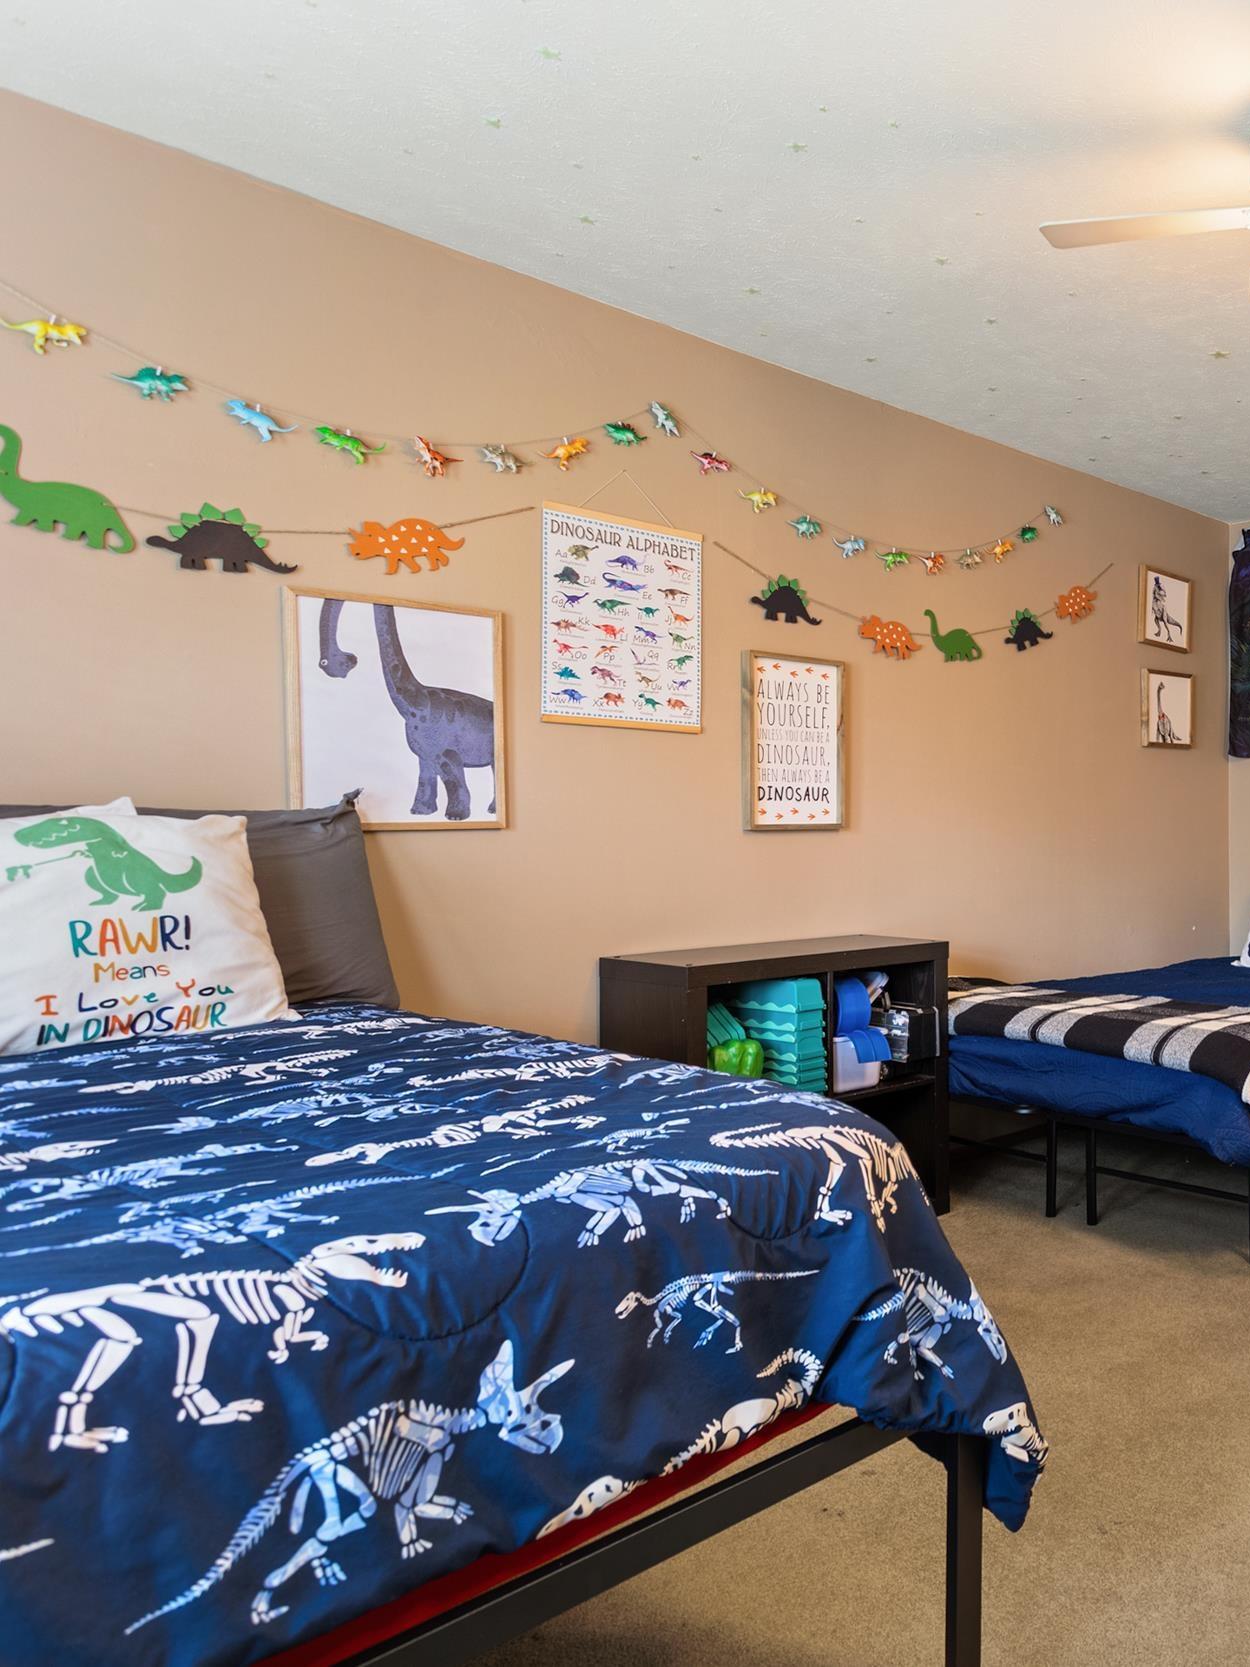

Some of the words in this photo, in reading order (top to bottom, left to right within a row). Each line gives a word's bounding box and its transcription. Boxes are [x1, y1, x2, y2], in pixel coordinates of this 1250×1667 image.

[551, 519, 621, 547] DINOSAUR
[626, 535, 696, 561] ALPHABET
[757, 678, 809, 701] ALWAYS
[816, 683, 830, 705] BE
[757, 702, 830, 730] YOURSELF,
[757, 727, 783, 742] UNLESS
[785, 730, 799, 742] YOU
[800, 730, 815, 743] CAN
[816, 731, 824, 744] BE
[826, 732, 830, 743] A
[757, 767, 778, 783] THEN
[782, 768, 812, 784] ALWAYS
[814, 769, 823, 784] BE
[825, 769, 830, 784] A
[757, 785, 830, 804] DINOSAUR
[69, 915, 191, 958] RAWR!
[93, 962, 171, 984] Means
[35, 995, 59, 1016] I
[37, 1022, 69, 1046] IN
[83, 1002, 229, 1042] DINOSAUR
